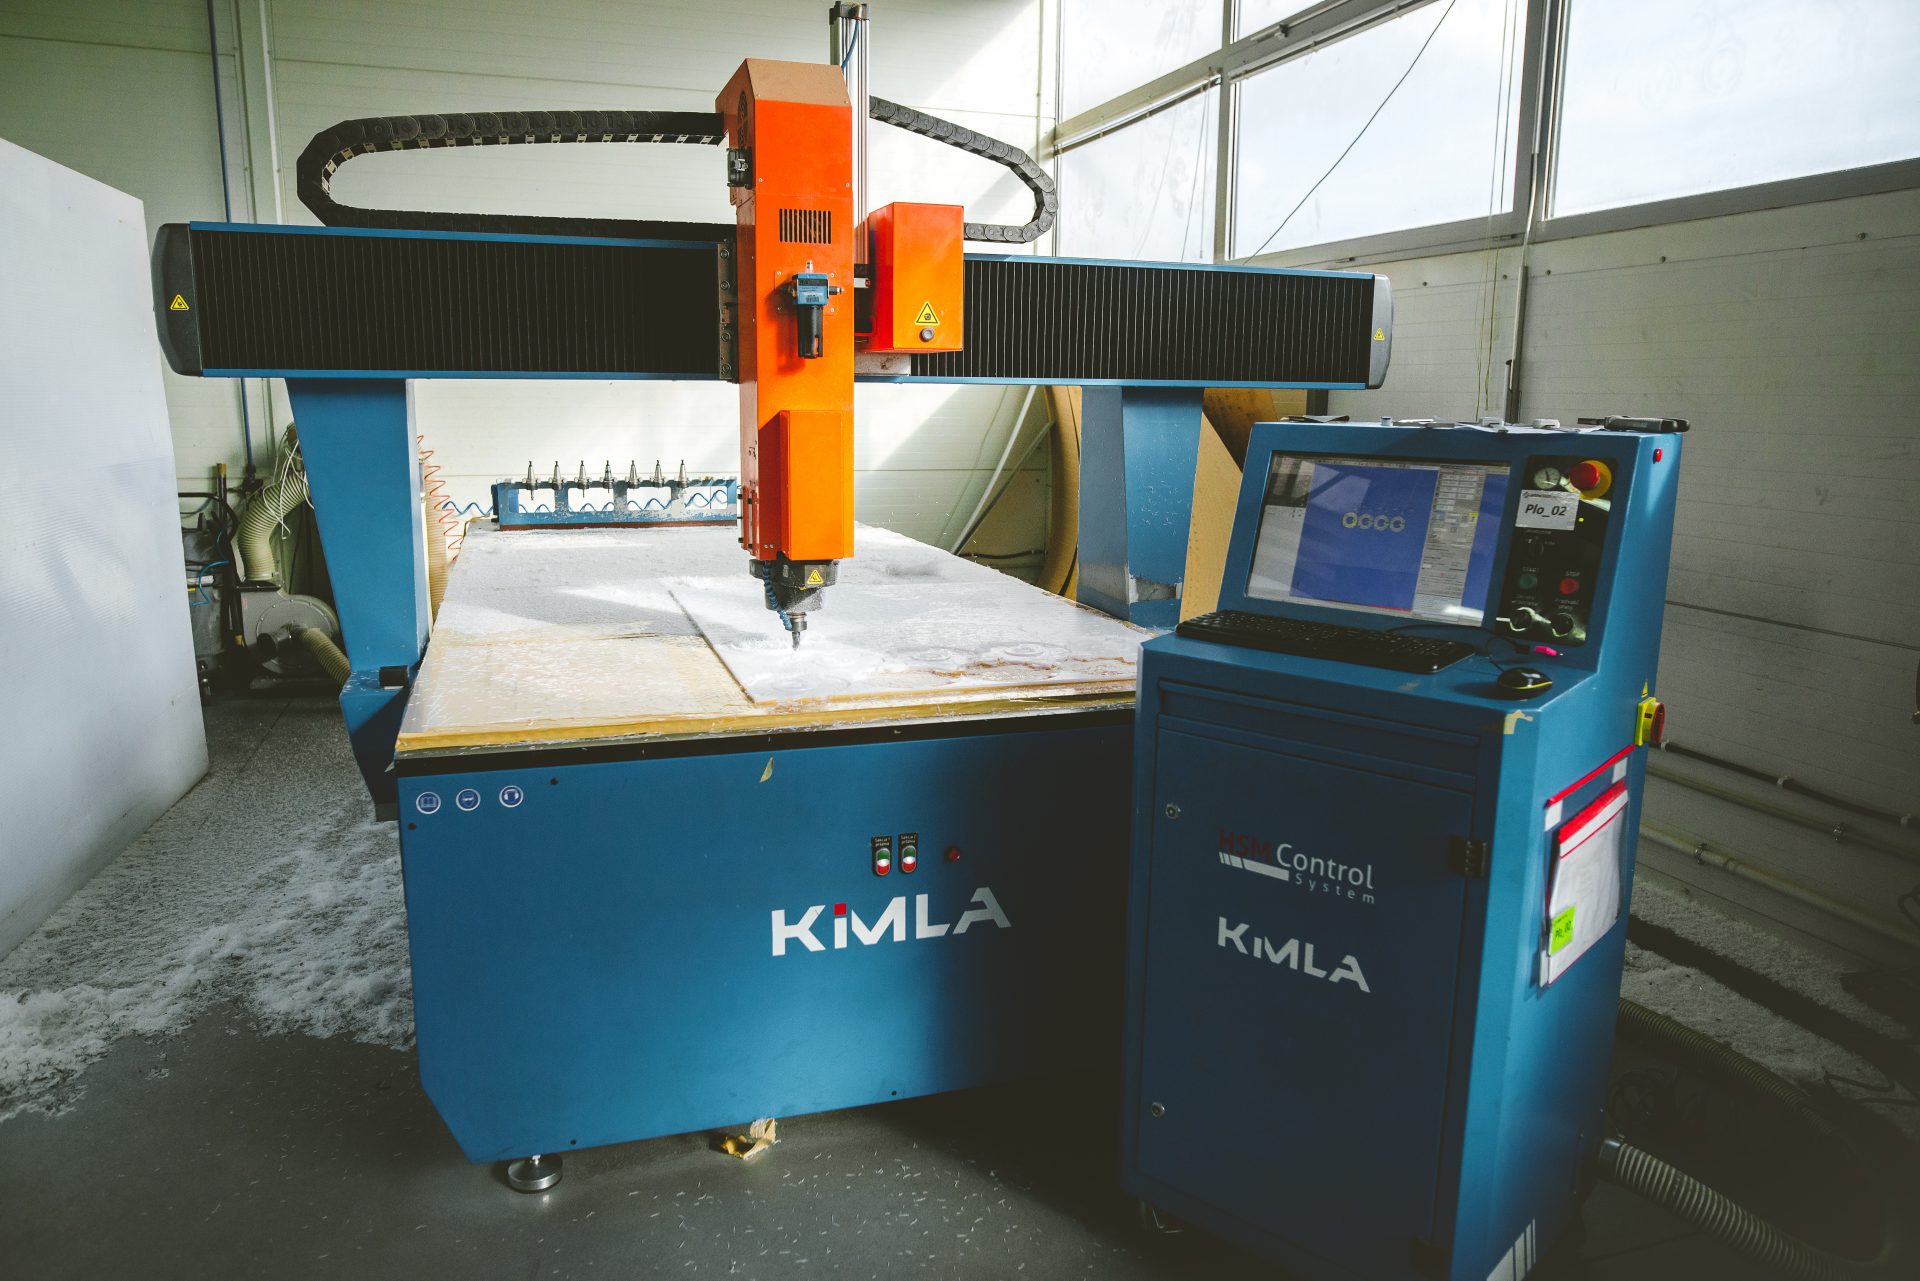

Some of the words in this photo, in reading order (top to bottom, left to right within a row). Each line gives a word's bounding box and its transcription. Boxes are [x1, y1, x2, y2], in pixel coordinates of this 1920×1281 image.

[1524, 503, 1567, 518] Plo_02
[1217, 830, 1273, 864] HSM
[1276, 843, 1374, 890] Control
[1295, 872, 1375, 905] System
